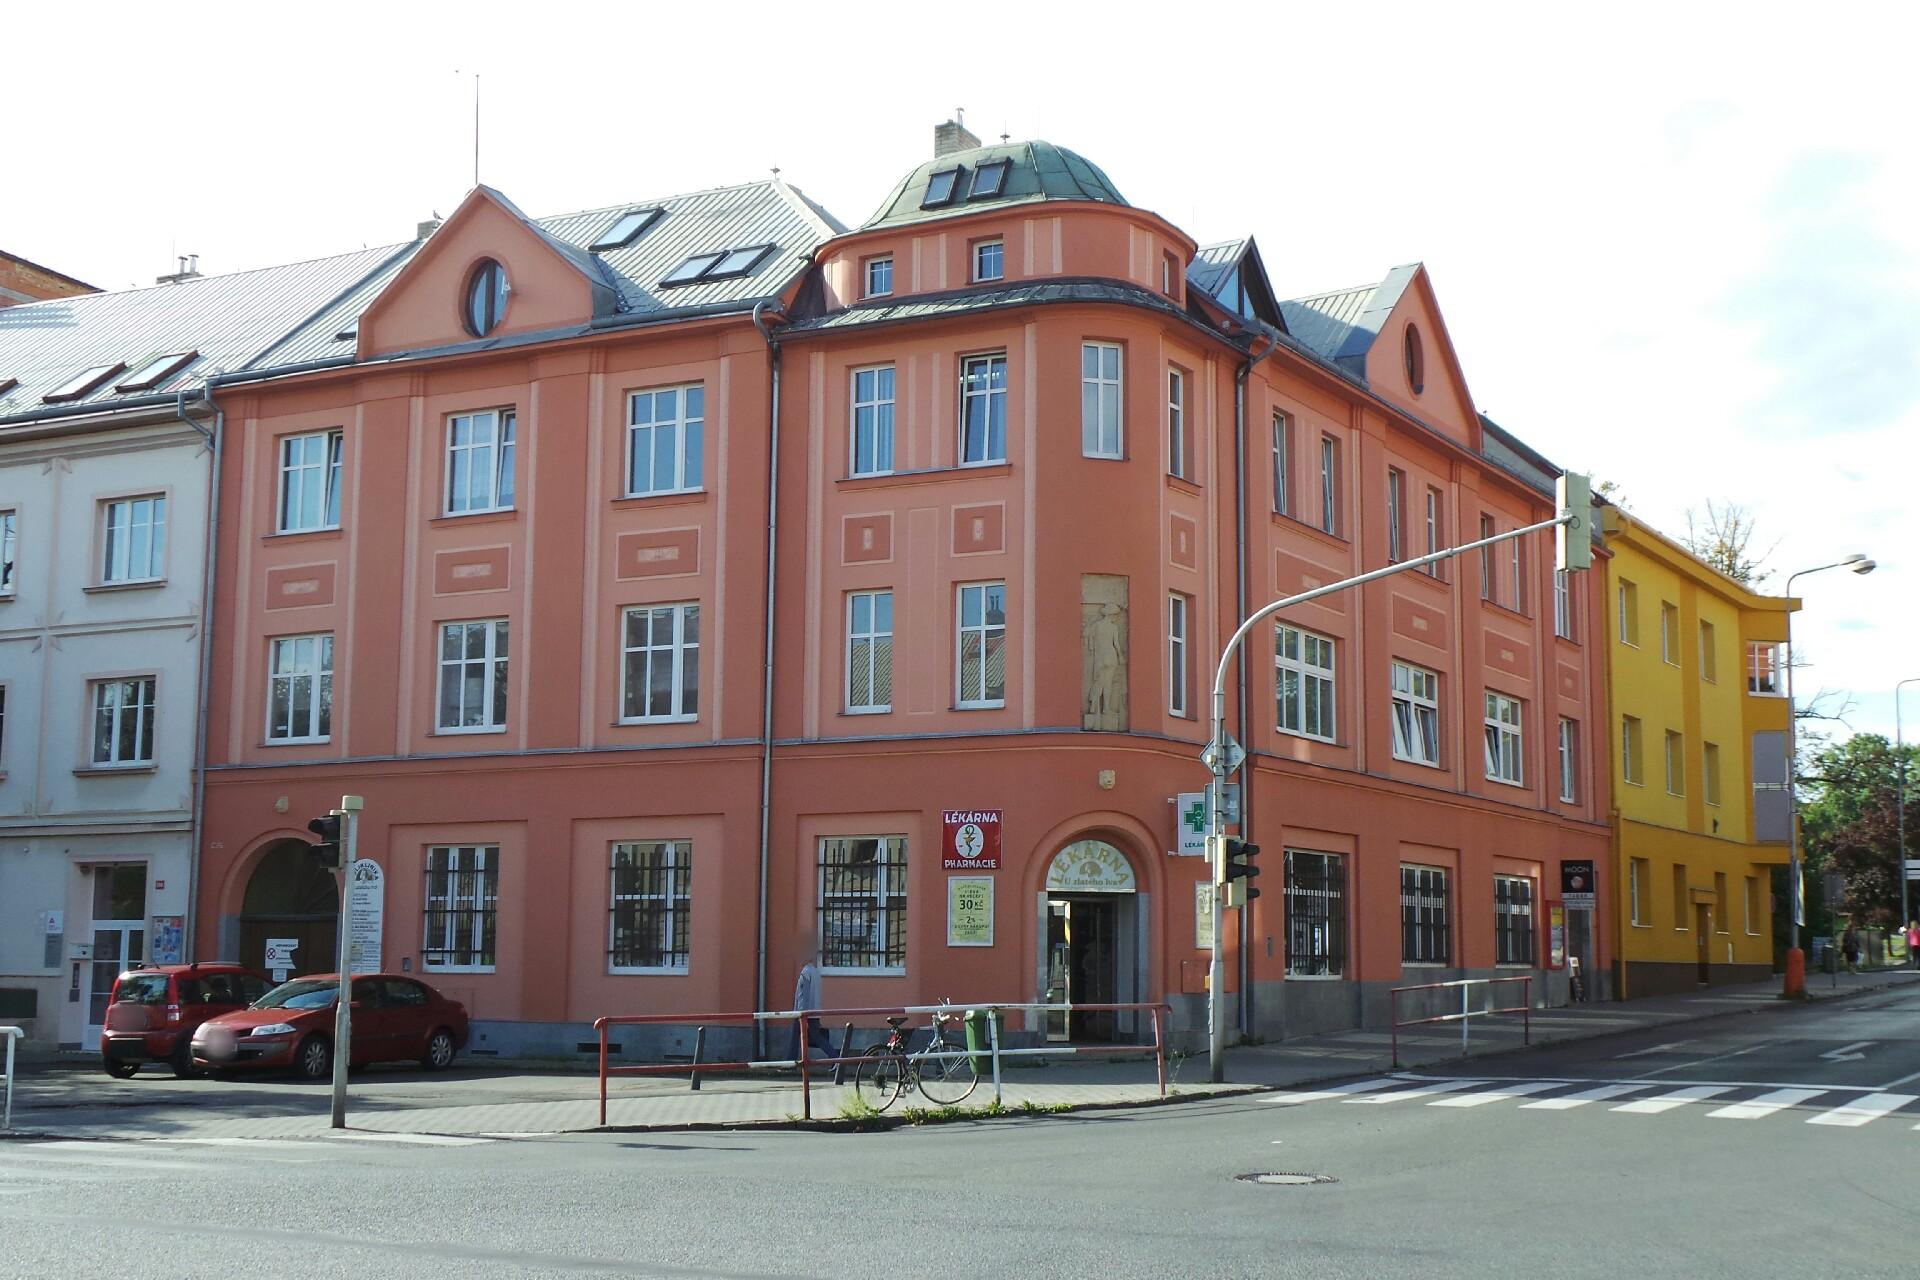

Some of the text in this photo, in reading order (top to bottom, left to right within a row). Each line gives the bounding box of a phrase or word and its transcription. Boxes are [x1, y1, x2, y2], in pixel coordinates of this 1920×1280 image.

[945, 811, 998, 823] LÉKÁRNA
[1184, 840, 1205, 848] LÉKÁR
[944, 859, 997, 868] PHARMACIE
[1050, 842, 1129, 884] LÉKÁRNA
[959, 899, 973, 910] 30
